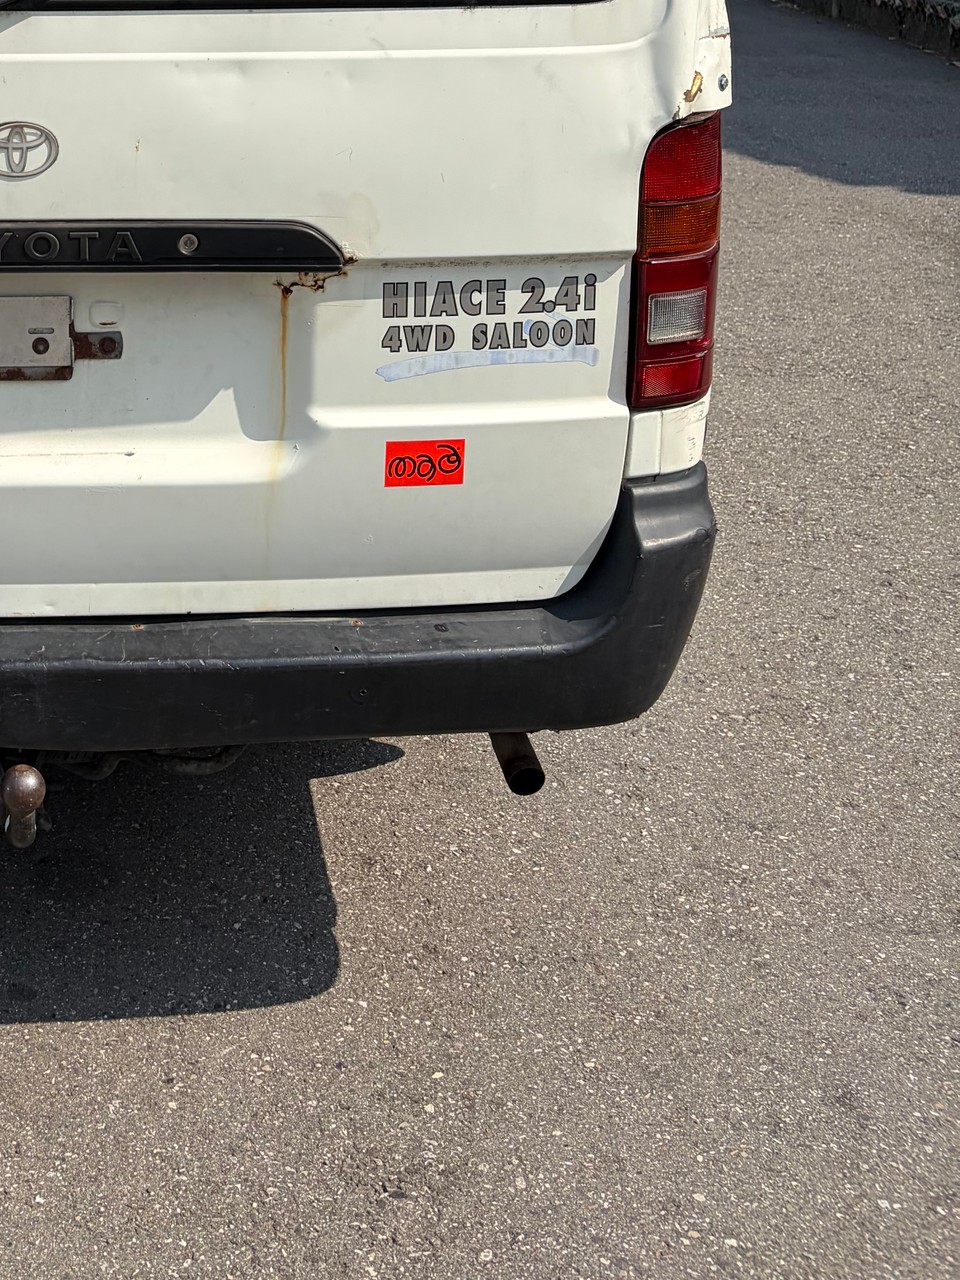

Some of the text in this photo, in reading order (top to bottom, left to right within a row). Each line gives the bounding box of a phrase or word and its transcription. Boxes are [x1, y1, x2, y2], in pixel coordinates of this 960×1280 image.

[381, 273, 598, 319] HIACE 2.4i
[381, 318, 596, 353] 4WD SALOON
